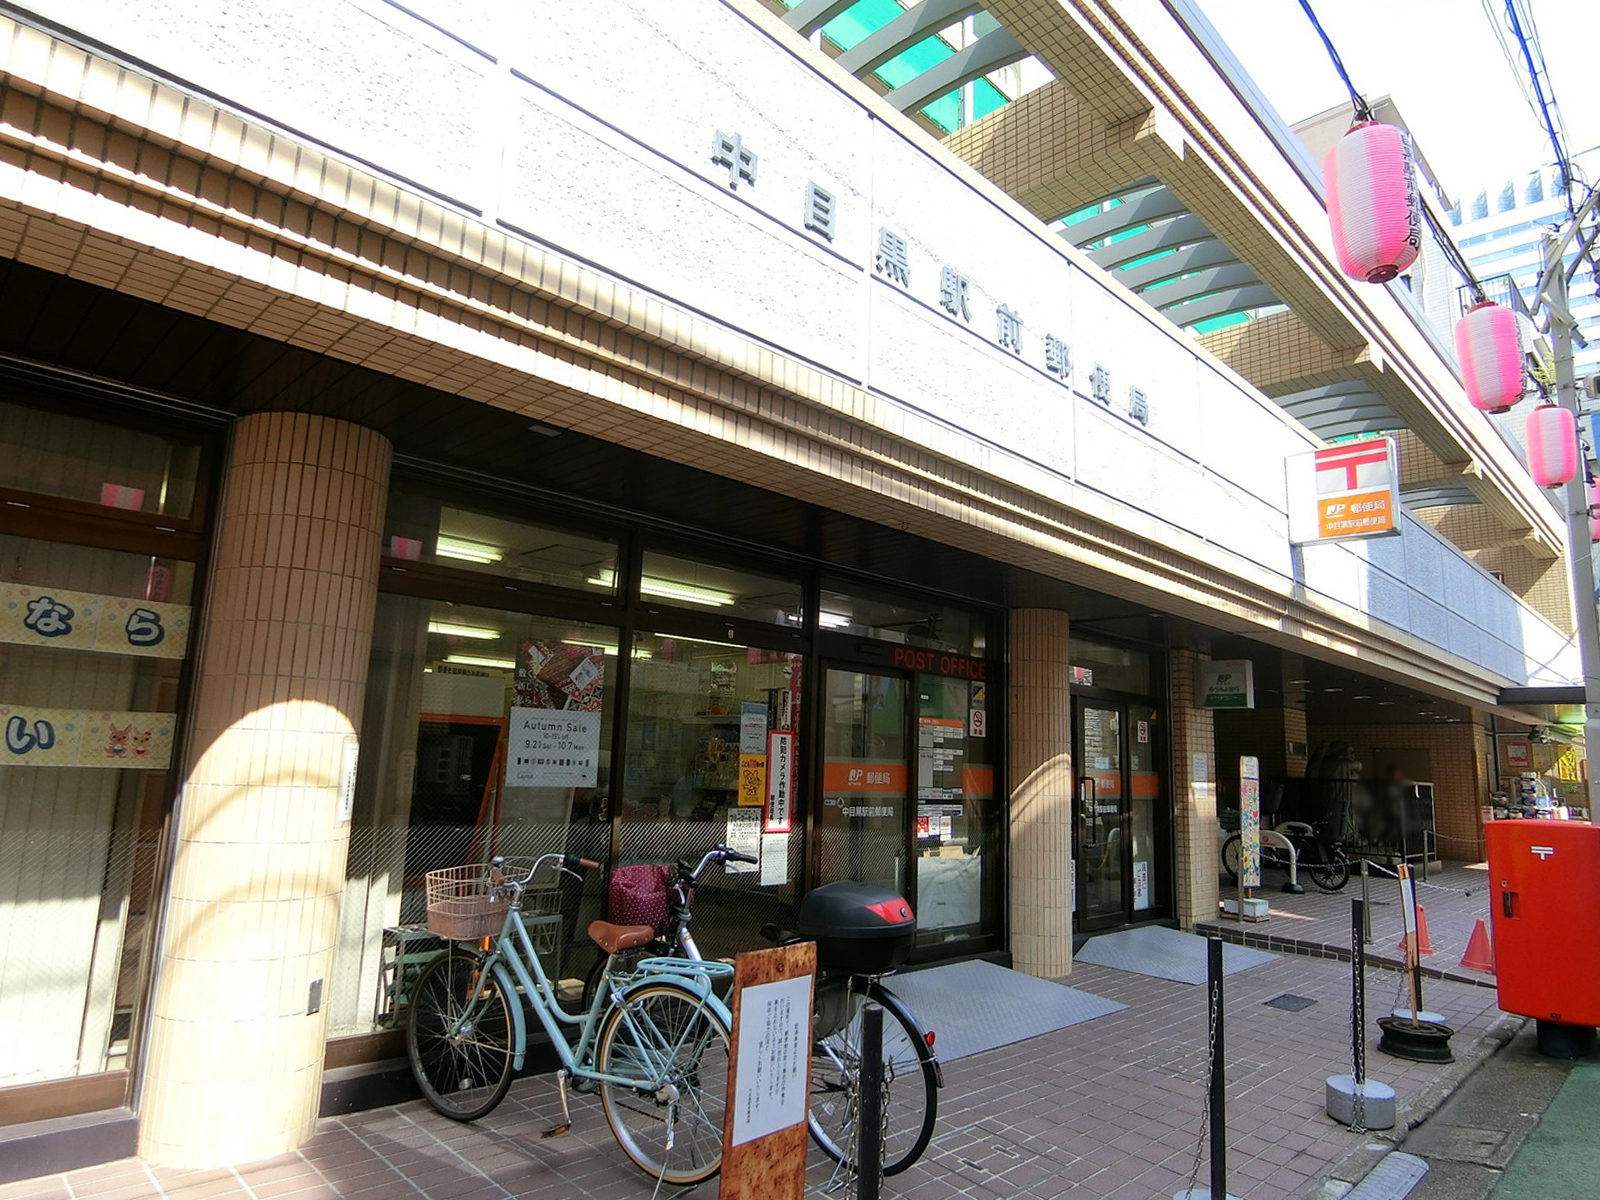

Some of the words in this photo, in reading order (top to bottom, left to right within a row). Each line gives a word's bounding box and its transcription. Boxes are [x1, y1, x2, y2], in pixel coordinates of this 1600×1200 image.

[711, 128, 1148, 426] 中目黒駅前郵便局
[1350, 500, 1386, 513] 郵便局
[895, 648, 935, 671] POST
[941, 657, 986, 680] OFFICE
[523, 720, 563, 732] Autumn
[566, 722, 588, 733] Sale
[777, 736, 788, 825] 防犯カメラ作動中です
[865, 771, 891, 785] 郵便局
[842, 807, 894, 817] 中目黒駅前郵便局
